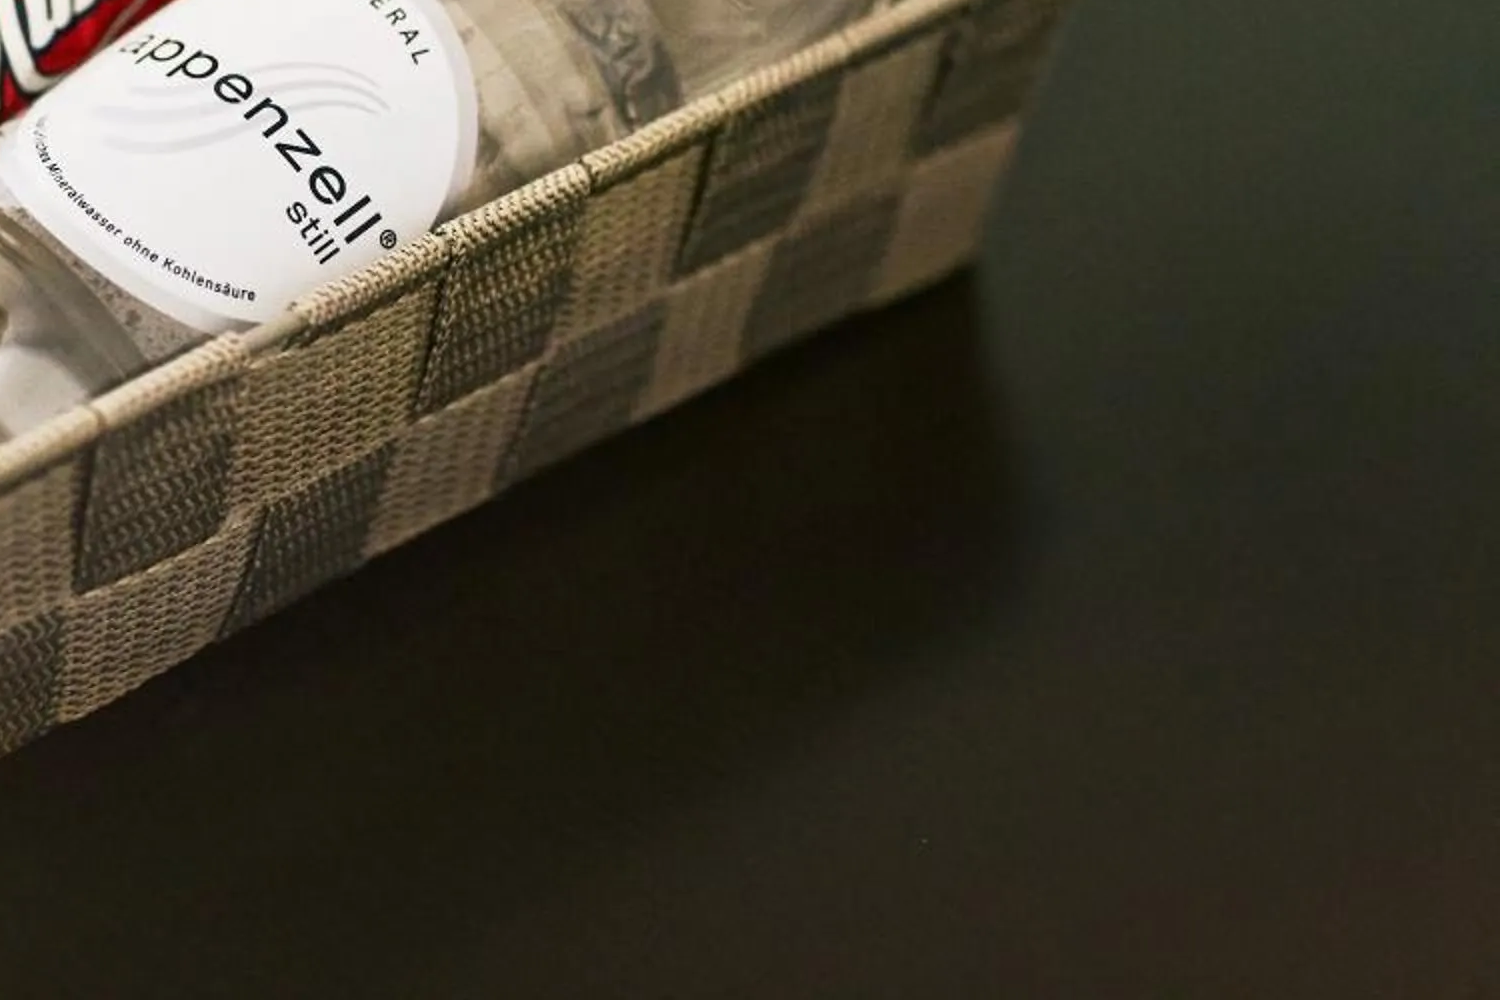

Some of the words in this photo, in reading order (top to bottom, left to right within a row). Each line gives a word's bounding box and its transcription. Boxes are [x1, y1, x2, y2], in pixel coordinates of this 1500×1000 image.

[46, 162, 124, 237] Mineralwasser
[123, 235, 160, 263] ohne
[162, 256, 257, 302] Kohlensäure
[286, 201, 341, 265] still
